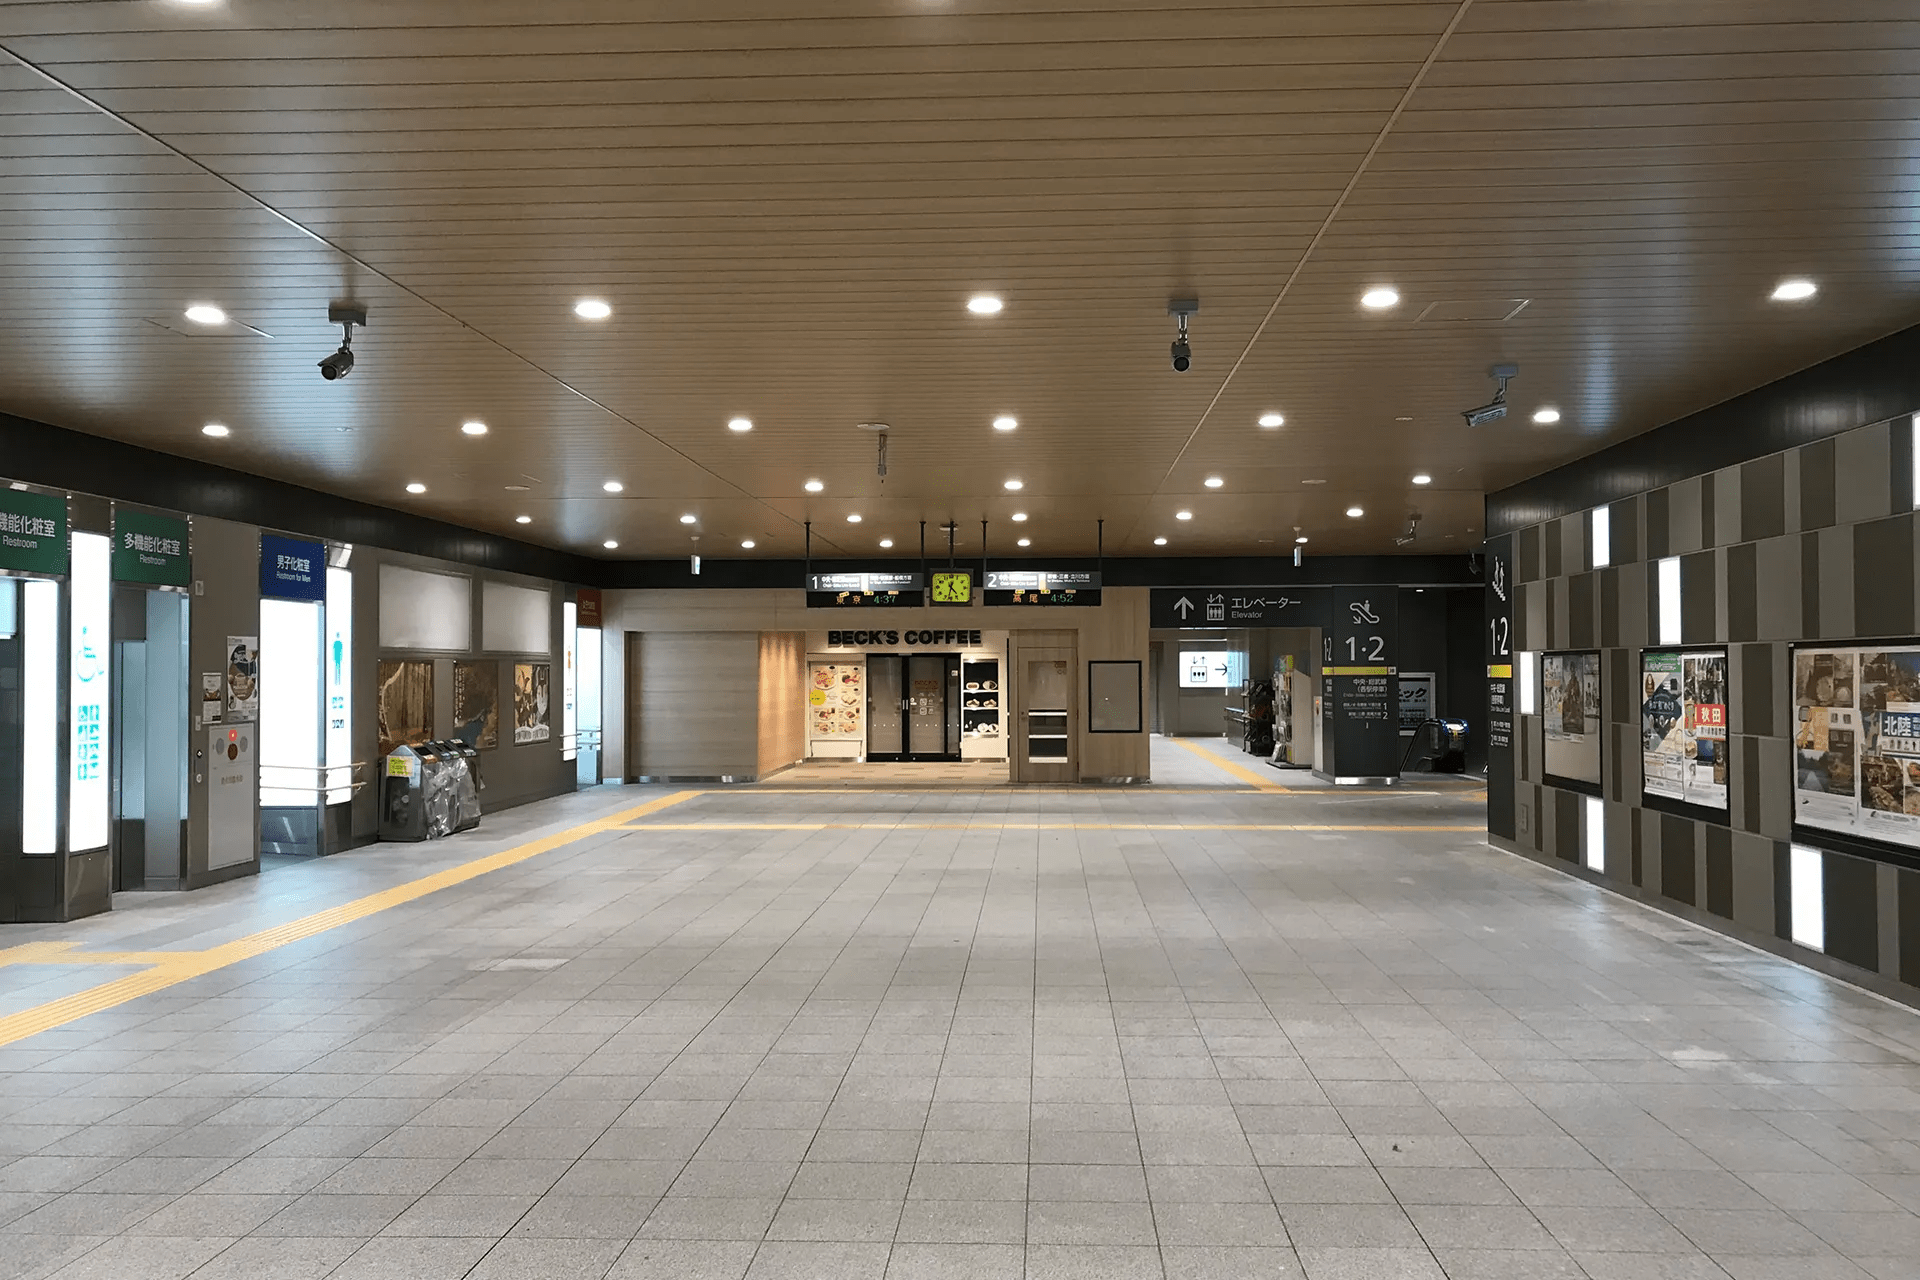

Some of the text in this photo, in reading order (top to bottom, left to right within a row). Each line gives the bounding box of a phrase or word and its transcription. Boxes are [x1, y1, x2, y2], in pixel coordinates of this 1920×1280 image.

[2, 535, 38, 549] Restroom
[124, 532, 181, 556] 多機能化粧室
[140, 553, 166, 566] Restroom
[811, 575, 818, 590] 1
[987, 573, 997, 588] 2
[873, 595, 896, 604] 4:37
[1050, 593, 1073, 603] 4:52
[1231, 597, 1301, 609] エレベーター
[1231, 611, 1263, 619] Elevator
[828, 630, 982, 645] BECK'S COFFEE
[1383, 702, 1387, 710] 1
[1382, 711, 1388, 720] 2
[1884, 715, 1912, 737] 北陸
